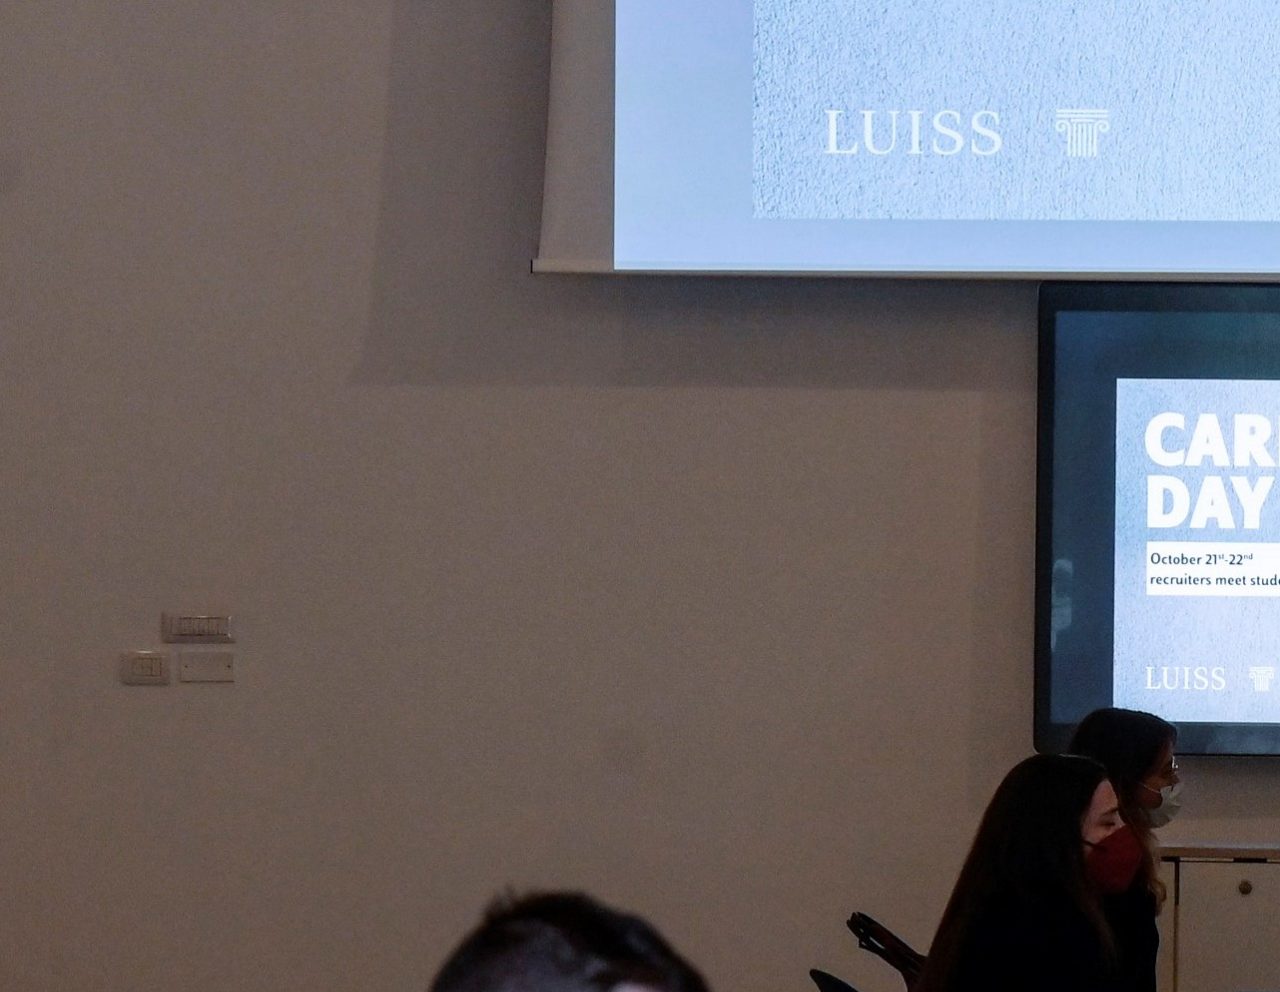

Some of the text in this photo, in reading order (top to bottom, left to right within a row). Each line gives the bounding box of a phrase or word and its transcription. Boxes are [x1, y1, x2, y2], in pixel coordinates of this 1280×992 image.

[824, 109, 1003, 156] LUISS
[1146, 475, 1276, 530] DAY
[1150, 552, 1202, 565] October
[1150, 573, 1212, 586] recruiters
[1215, 575, 1247, 586] meet
[1145, 666, 1226, 691] LUISS
